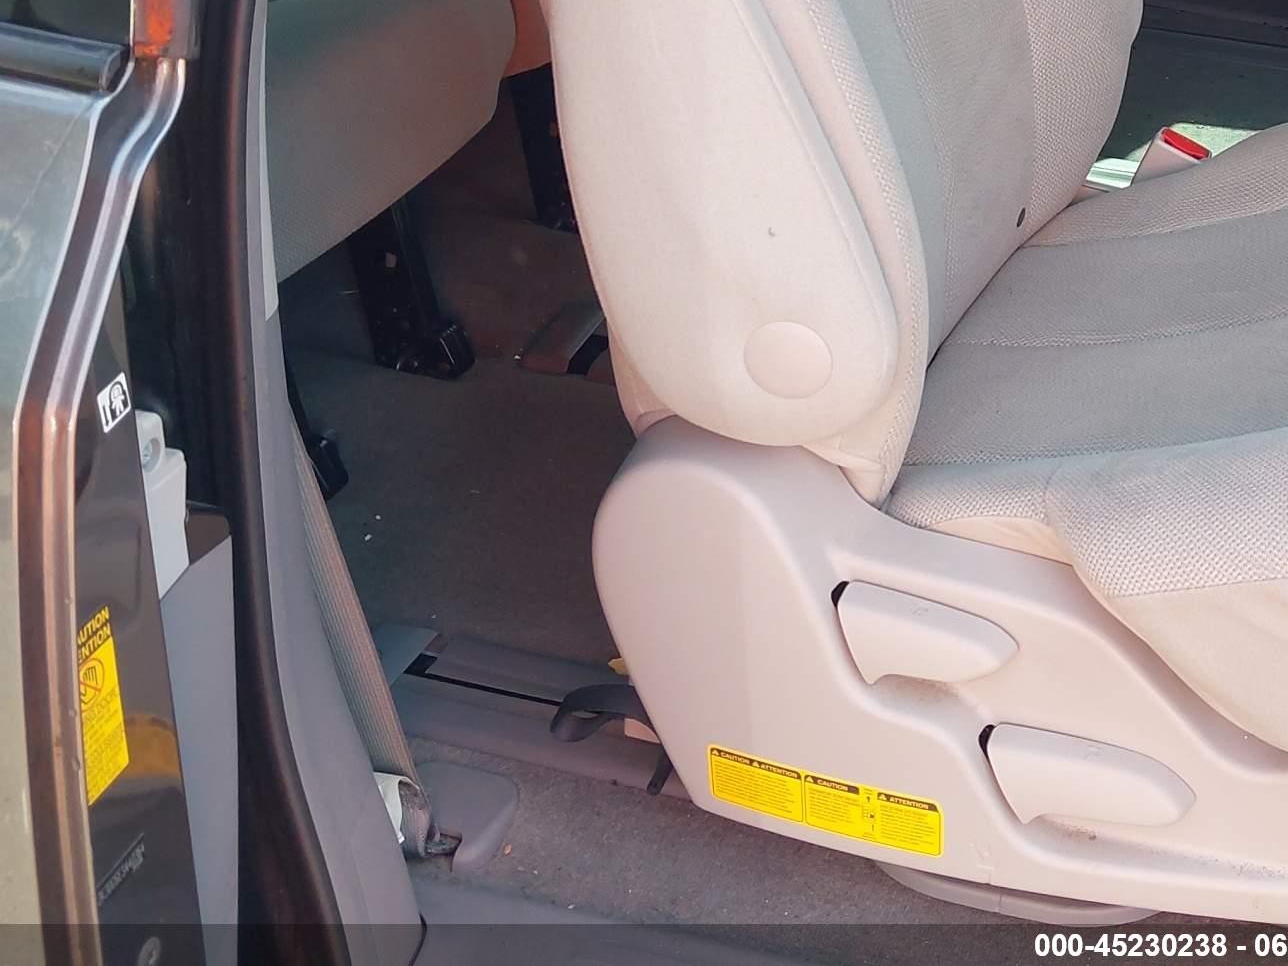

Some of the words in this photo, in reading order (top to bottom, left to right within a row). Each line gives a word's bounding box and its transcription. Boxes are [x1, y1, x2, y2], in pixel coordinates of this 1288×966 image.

[720, 751, 751, 765] CAUTION
[760, 763, 798, 778] ATTENTION
[816, 778, 849, 792] CAUTION
[889, 796, 929, 810] ATTENTION
